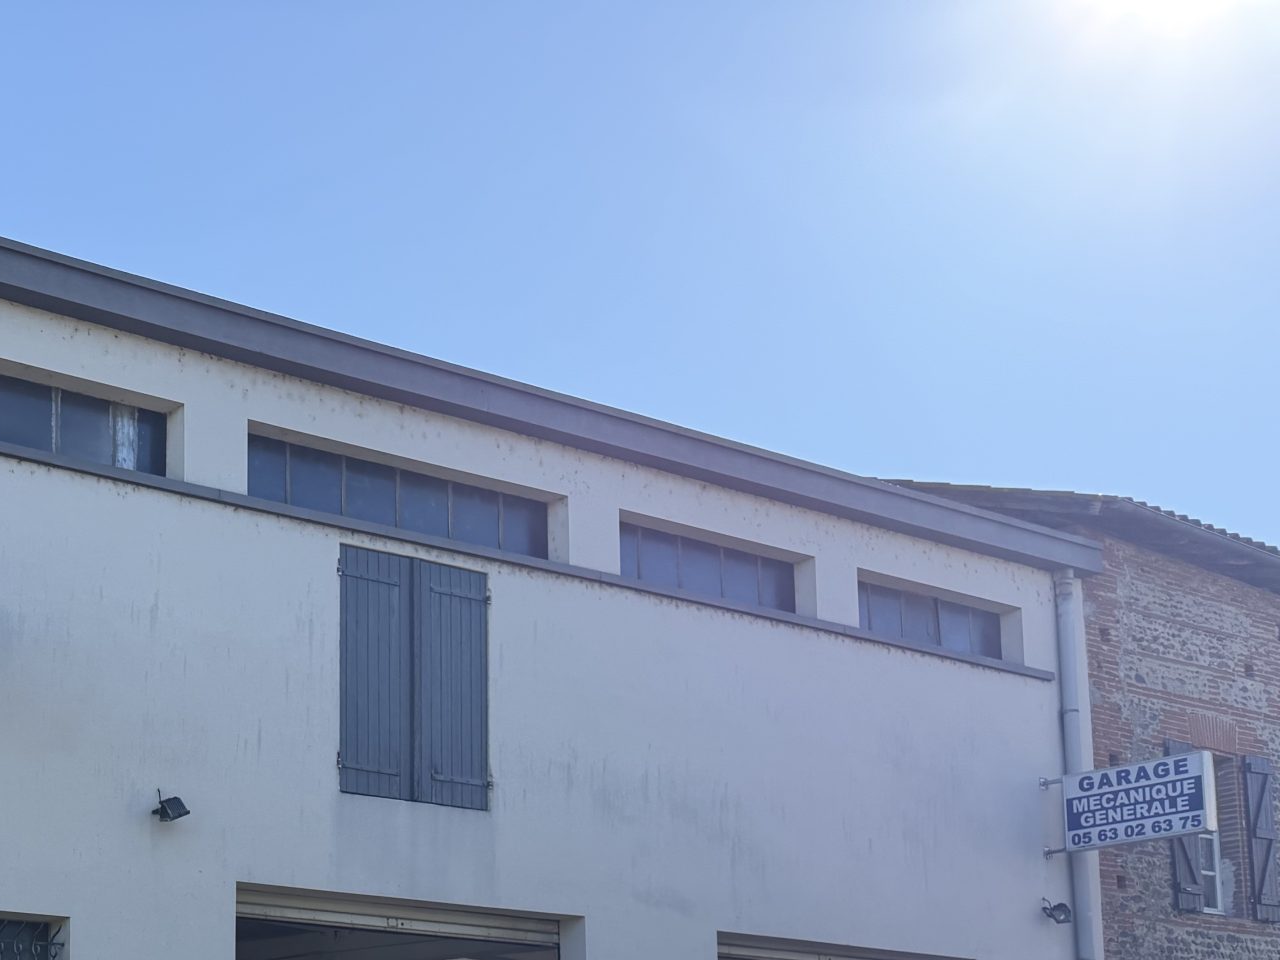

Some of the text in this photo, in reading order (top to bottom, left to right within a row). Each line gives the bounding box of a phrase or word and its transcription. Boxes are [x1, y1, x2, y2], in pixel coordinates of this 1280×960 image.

[1078, 757, 1189, 793] GARAGE
[1072, 779, 1196, 814] MECANIQUE
[1080, 796, 1190, 827] GENERALE
[1071, 814, 1202, 846] 05 63 02 63 75
